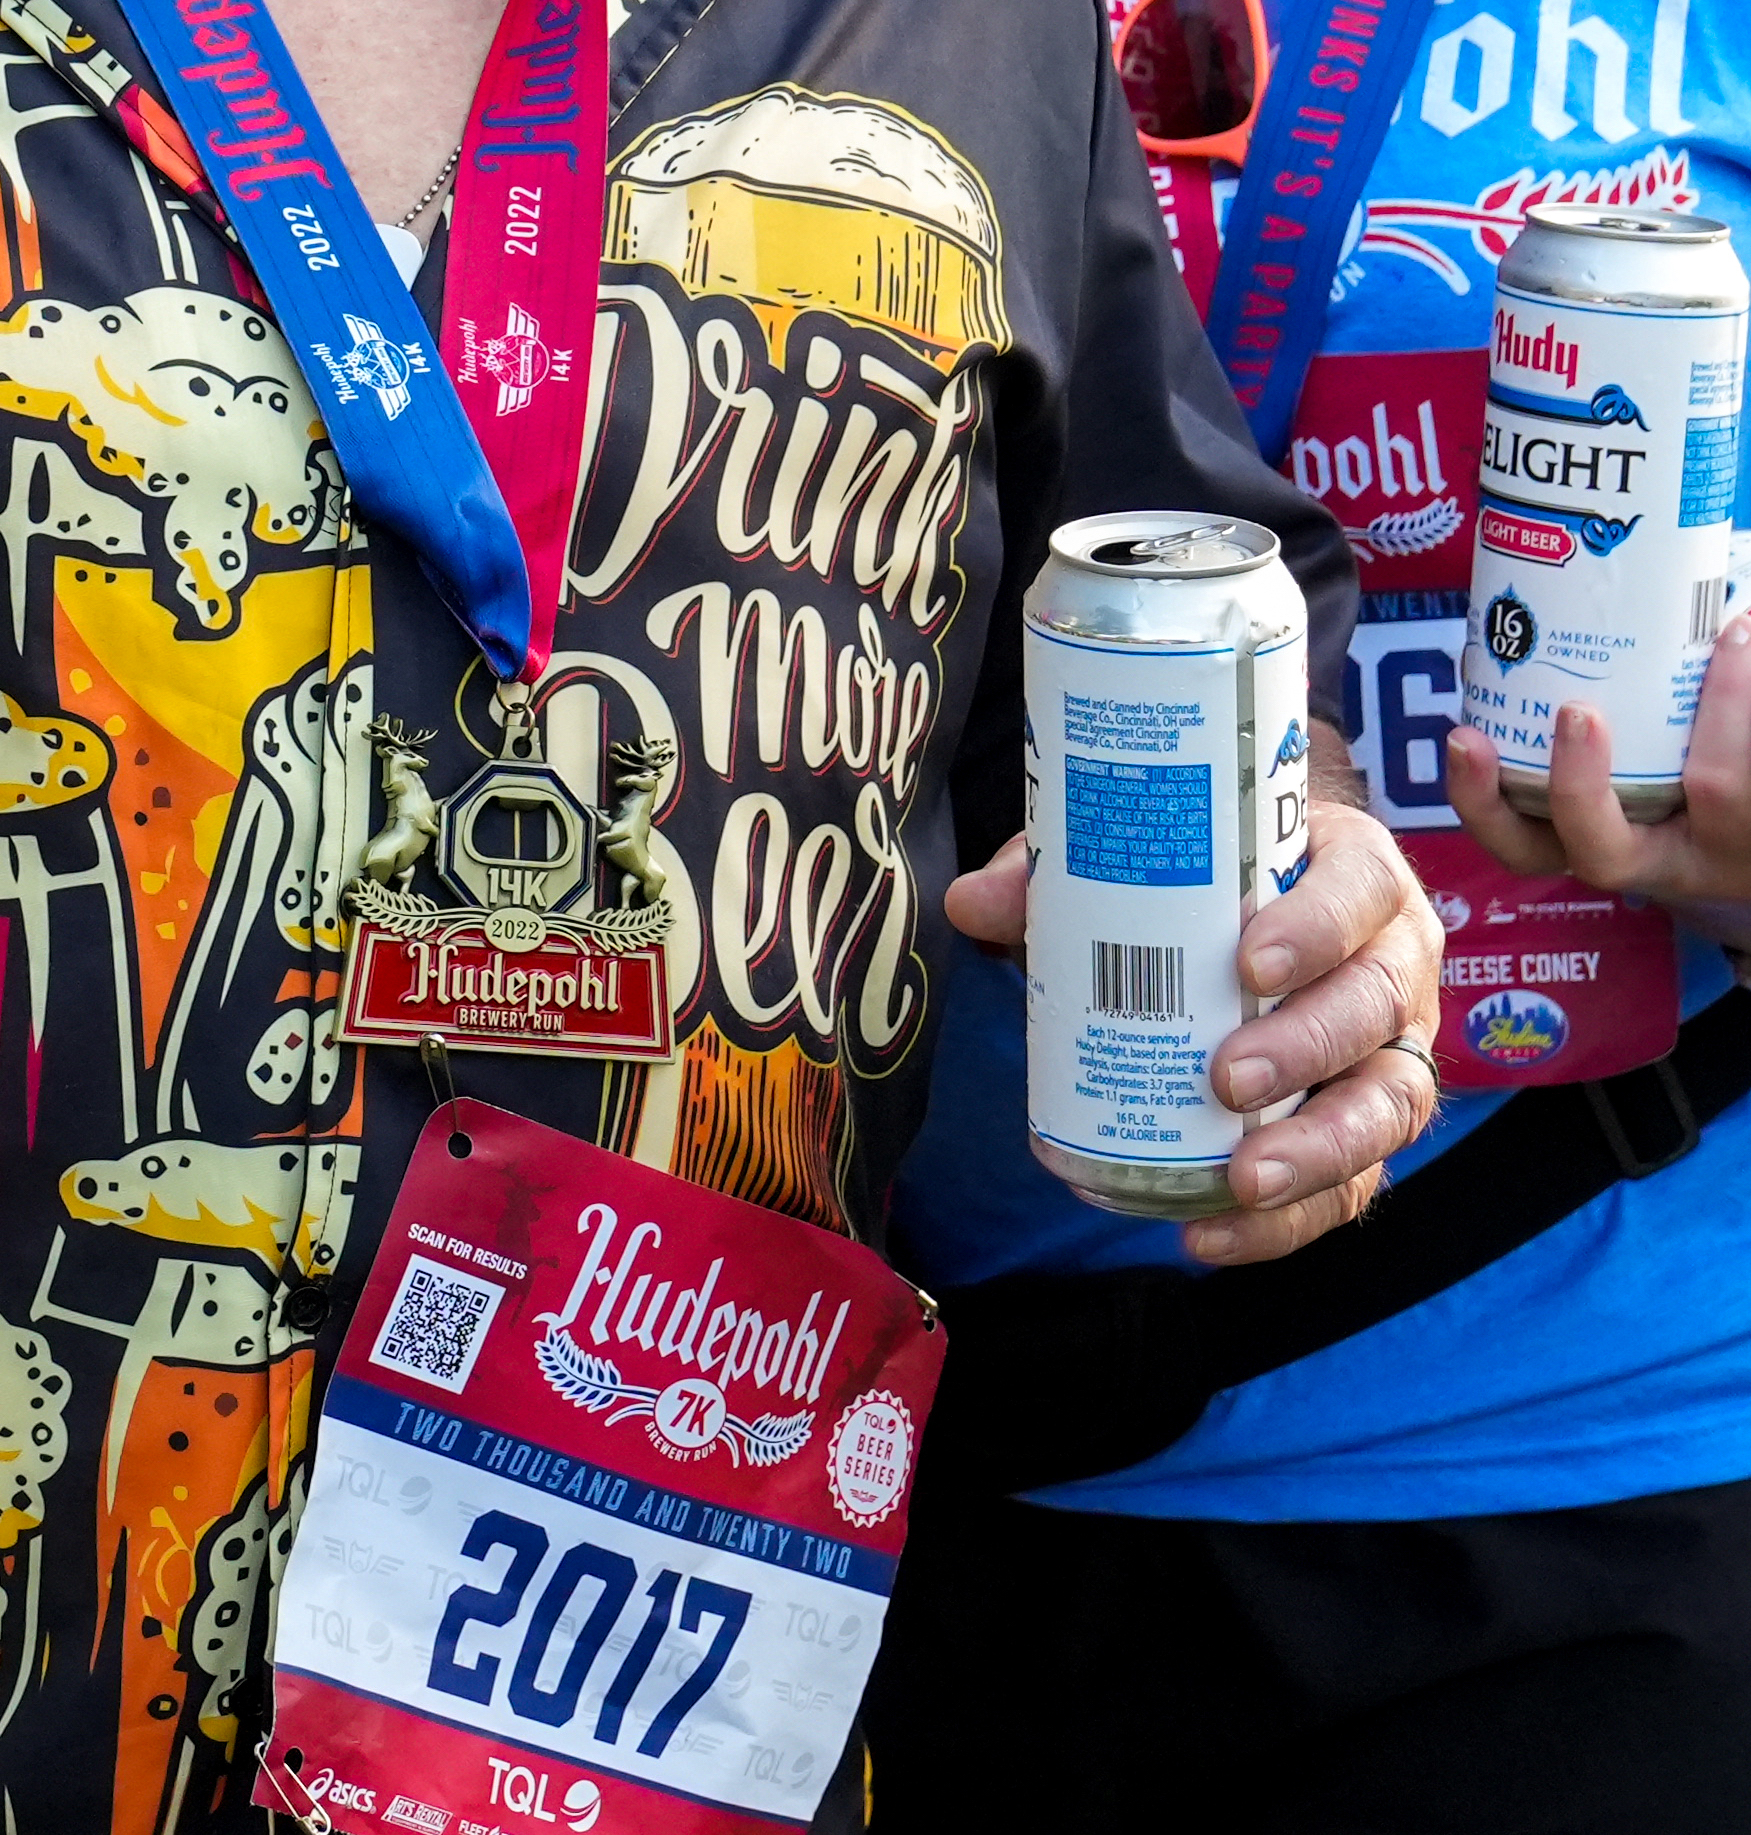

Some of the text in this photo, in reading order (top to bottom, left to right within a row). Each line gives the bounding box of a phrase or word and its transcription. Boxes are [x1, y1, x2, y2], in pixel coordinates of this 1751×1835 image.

[1276, 106, 1349, 201] IT'S
[505, 185, 543, 258] 2022
[1259, 215, 1307, 248] A
[282, 203, 339, 273] 2022
[402, 341, 431, 374] 14K
[457, 317, 479, 384] Hudepohl
[1495, 307, 1580, 390] Hudy
[549, 349, 574, 382] 14K
[562, 282, 981, 632] Drink
[1521, 527, 1563, 555] BEER
[1495, 604, 1524, 639] 16
[1492, 634, 1521, 659] OZ
[1547, 645, 1611, 663] OWNED
[1548, 629, 1636, 649] AMERICAN
[1143, 702, 1154, 716] by
[1156, 702, 1200, 715] Cincinnati
[1163, 716, 1177, 727] OH
[1179, 715, 1205, 727] under
[1521, 699, 1551, 719] IN
[1136, 726, 1180, 740] Cincinnati
[1163, 740, 1178, 752] OH
[488, 867, 548, 906] 14K
[491, 919, 540, 941] 2022
[401, 942, 620, 1015] Hudepohl
[1440, 951, 1601, 986] HEESE CONEY
[459, 1008, 563, 1031] BREWERY RUN
[1104, 1009, 1173, 1022] 72749 04161
[1087, 1025, 1191, 1047] Each 12-ounce serving of
[1130, 1046, 1156, 1060] based
[1158, 1051, 1170, 1060] on
[1172, 1050, 1207, 1062] average
[1086, 1070, 1195, 1094] Carbohydrates: 3.7 grams,
[1105, 1089, 1117, 1102] 1.1
[1098, 1124, 1182, 1142] LOW CALORIE BEER
[1117, 1112, 1139, 1125] 16 FL
[407, 1223, 528, 1280] SCAN FOR RESULTS
[532, 1202, 851, 1404] Hudepohl
[669, 1389, 717, 1437] 7K
[863, 1411, 887, 1433] TQL
[644, 1421, 718, 1463] BREWERY RUN
[856, 1434, 894, 1462] BEER
[844, 1456, 896, 1488] SERIES
[395, 1401, 853, 1579] TWO THOUSAND AND TWENTY TWO
[427, 1509, 753, 1761] 2017
[488, 1756, 557, 1823] TQL
